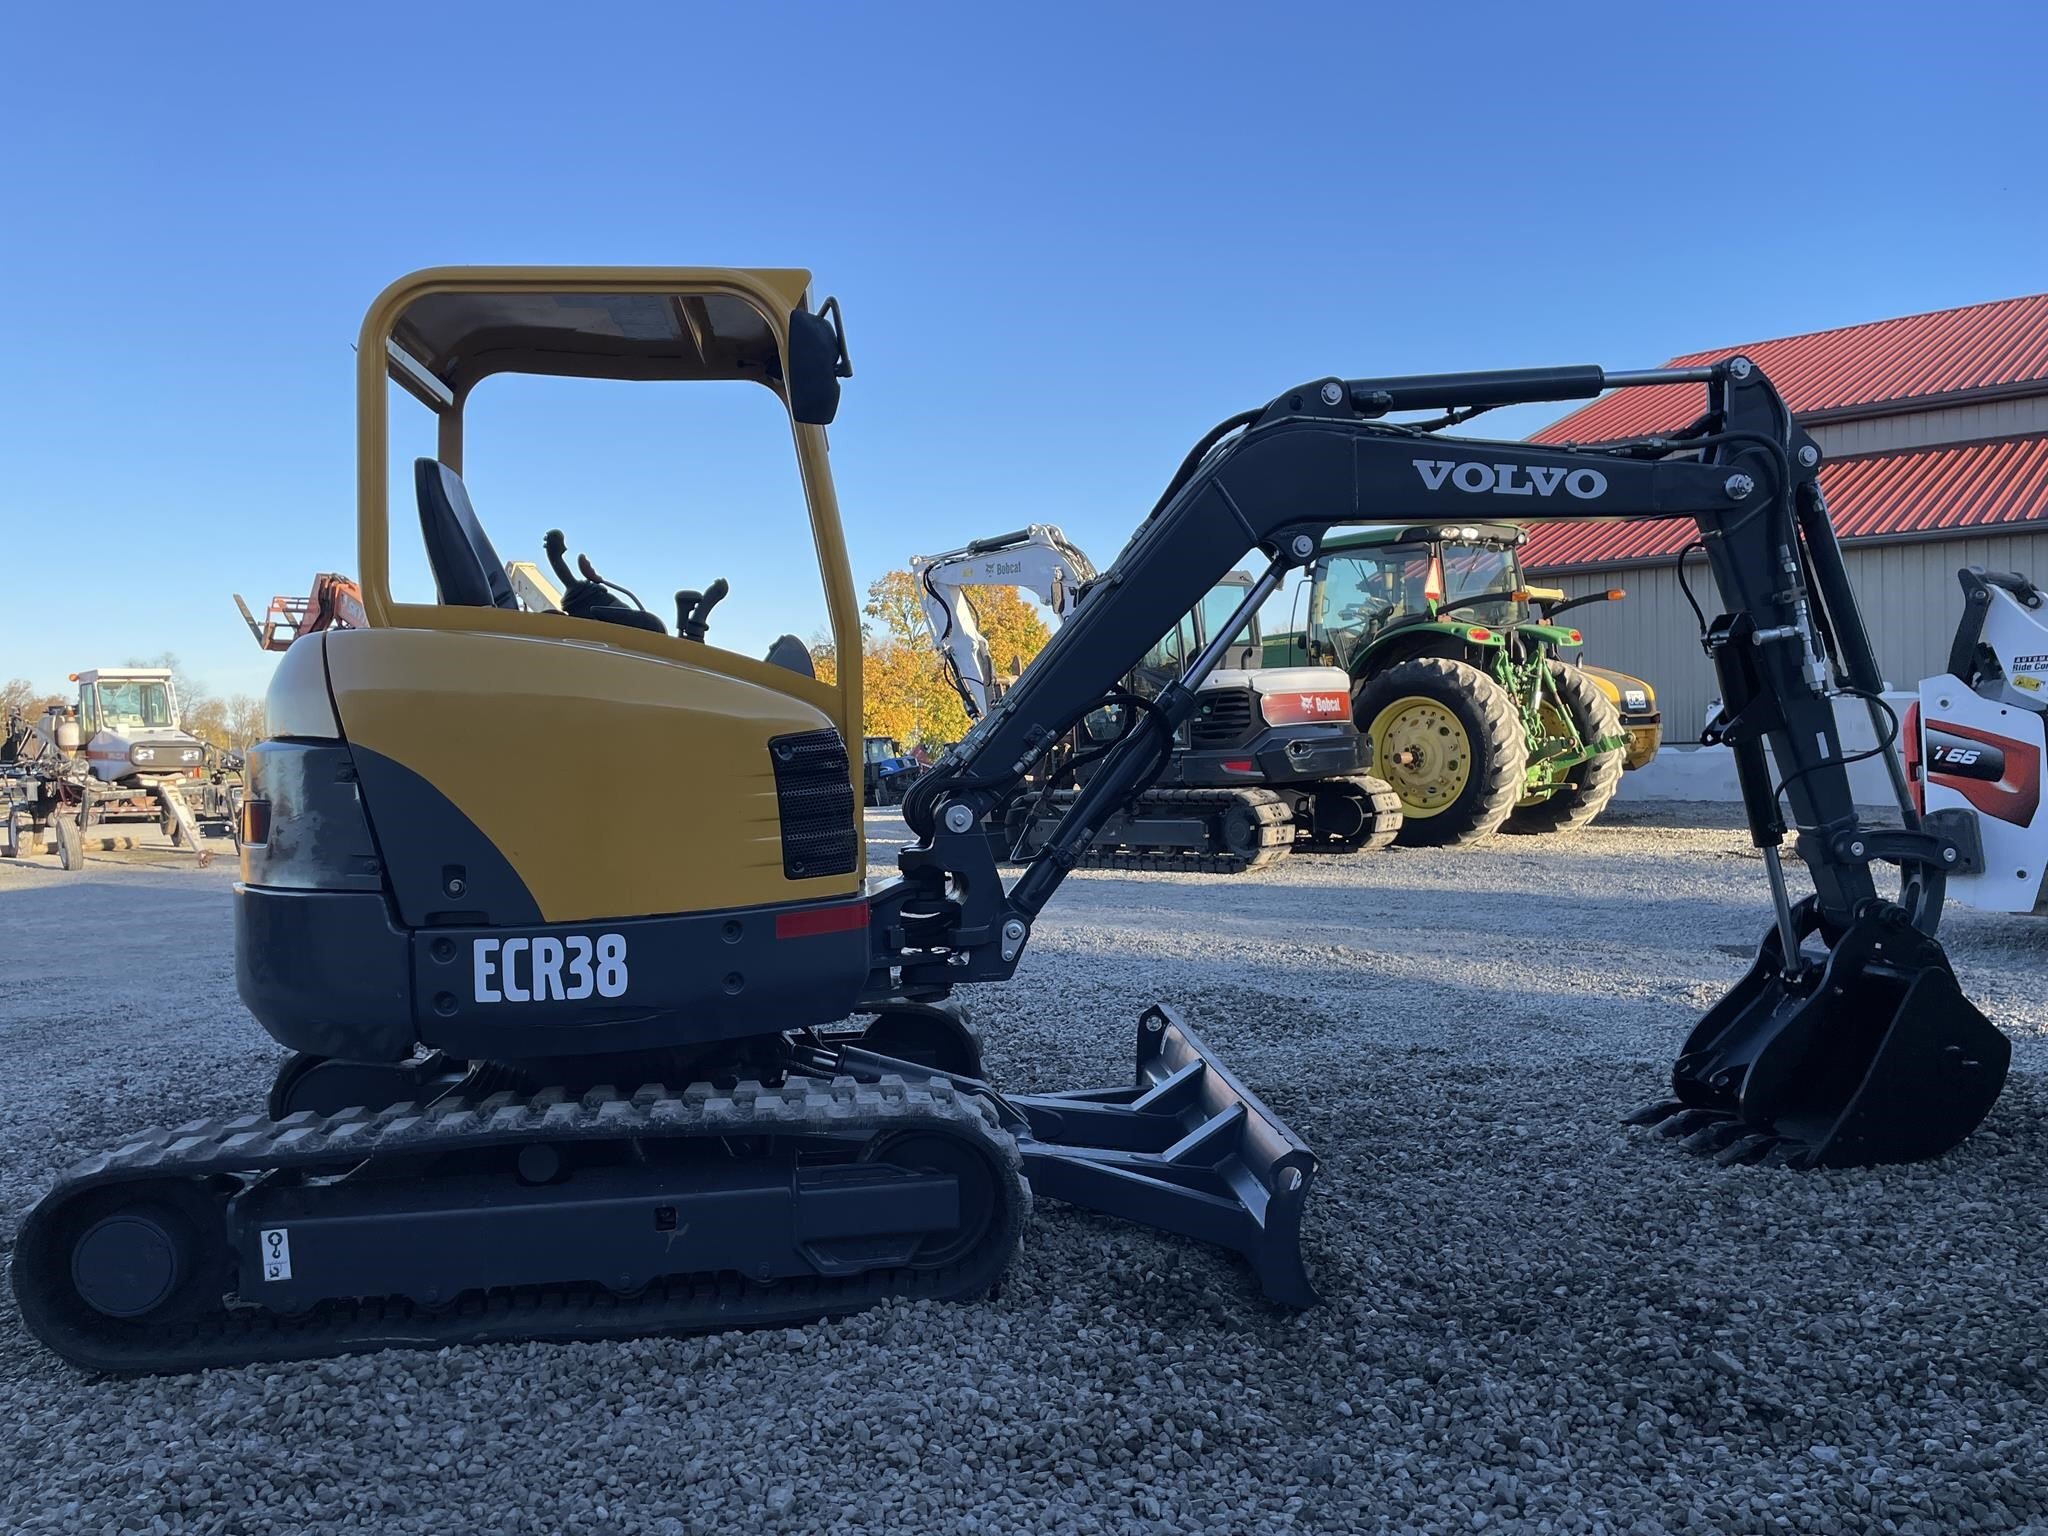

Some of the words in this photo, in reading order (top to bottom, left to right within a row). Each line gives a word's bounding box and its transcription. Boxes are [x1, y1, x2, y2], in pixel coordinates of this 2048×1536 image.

[1412, 459, 1608, 499] VOLVO
[996, 561, 1021, 575] Bobcat
[2015, 655, 2048, 663] AUTOM
[2013, 663, 2032, 671] Ride
[1315, 697, 1341, 712] Bobcat
[473, 933, 628, 1003] ECR38
